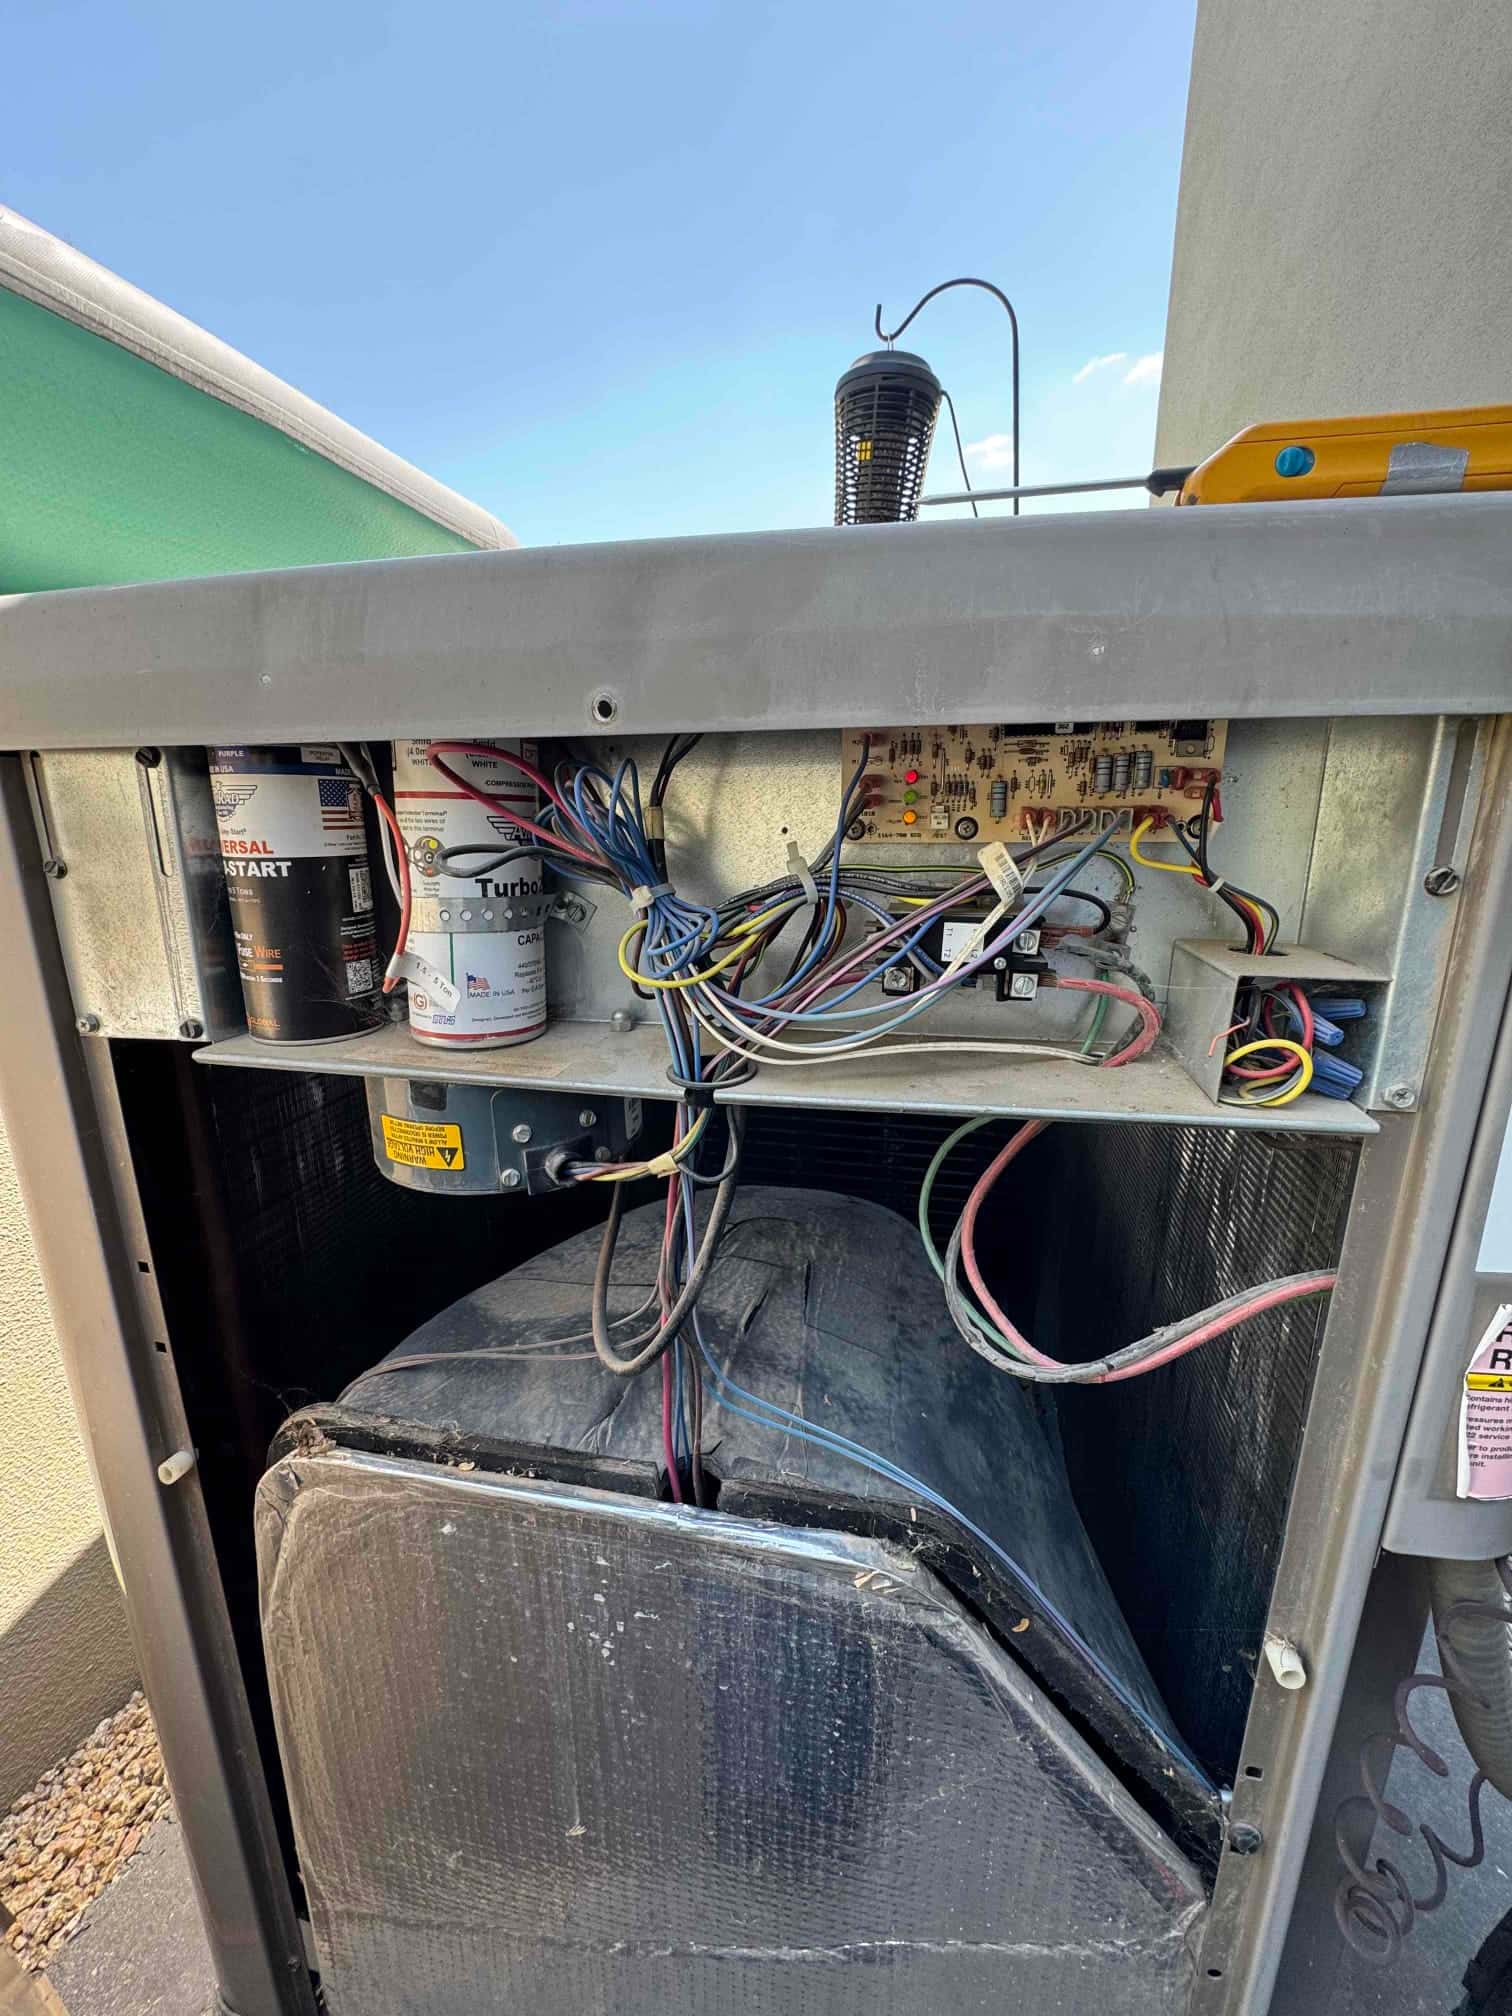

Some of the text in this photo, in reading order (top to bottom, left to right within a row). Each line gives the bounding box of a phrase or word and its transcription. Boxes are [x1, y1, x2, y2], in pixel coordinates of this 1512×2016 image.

[471, 761, 498, 769] WHITE
[222, 839, 274, 855] ERSAL
[223, 860, 292, 877] -START
[253, 945, 281, 958] WIRE
[440, 982, 453, 998] Ton
[1479, 1444, 1488, 1452] to
